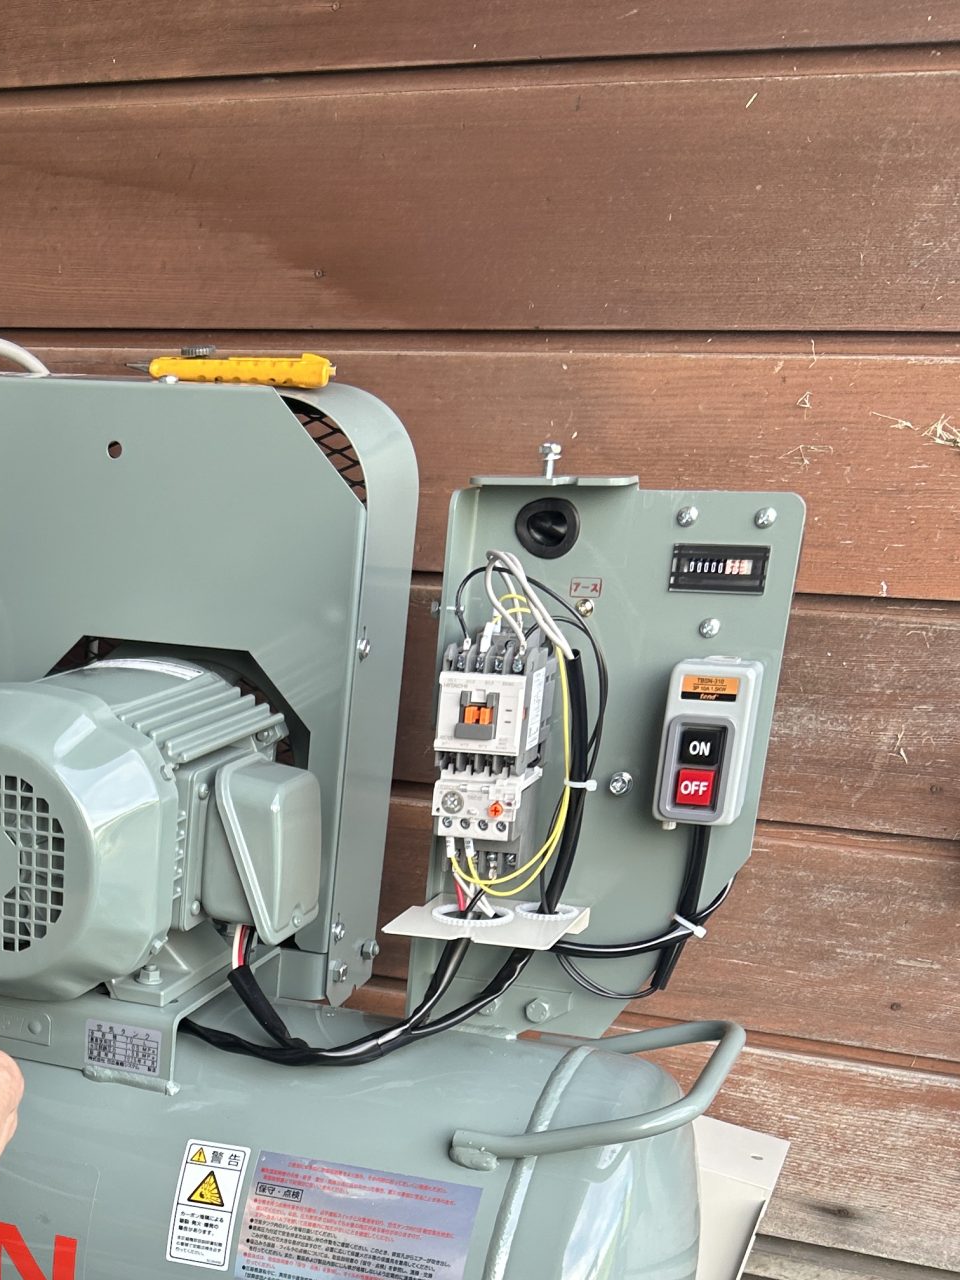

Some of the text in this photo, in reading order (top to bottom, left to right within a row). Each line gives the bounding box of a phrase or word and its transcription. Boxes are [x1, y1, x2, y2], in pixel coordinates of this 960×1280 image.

[572, 582, 599, 593] アース
[689, 740, 711, 757] ON
[680, 780, 709, 796] OFF
[210, 1150, 241, 1167] 警告
[258, 1184, 301, 1200] 保守・点検
